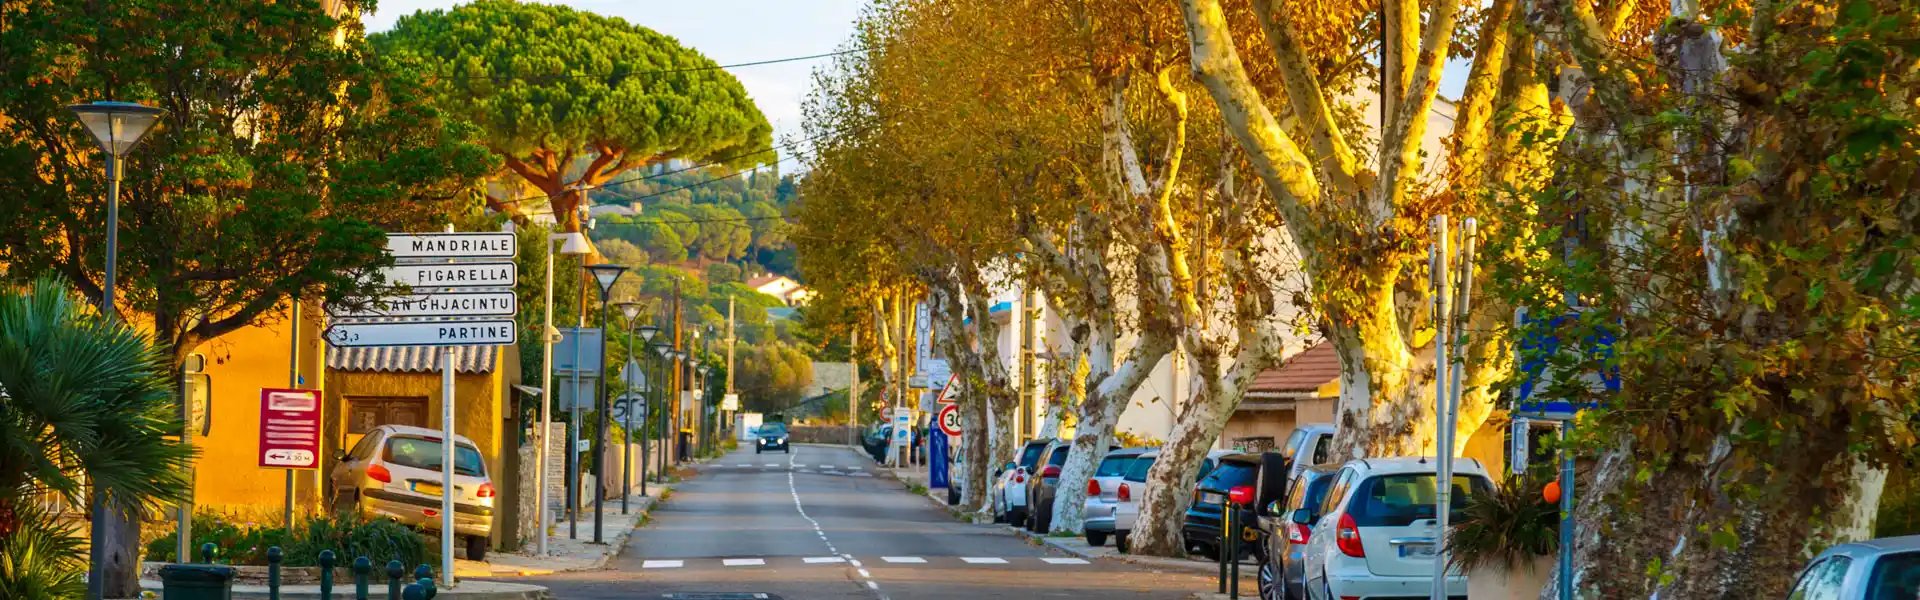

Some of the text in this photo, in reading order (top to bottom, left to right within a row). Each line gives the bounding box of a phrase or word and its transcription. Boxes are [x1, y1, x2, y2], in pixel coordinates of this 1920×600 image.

[412, 239, 509, 252] MANDRIALE
[418, 269, 508, 281] FIGARELLA
[380, 298, 509, 311] AN GHJACINTU
[439, 327, 508, 339] PARTINE
[919, 304, 928, 371] HOTEL
